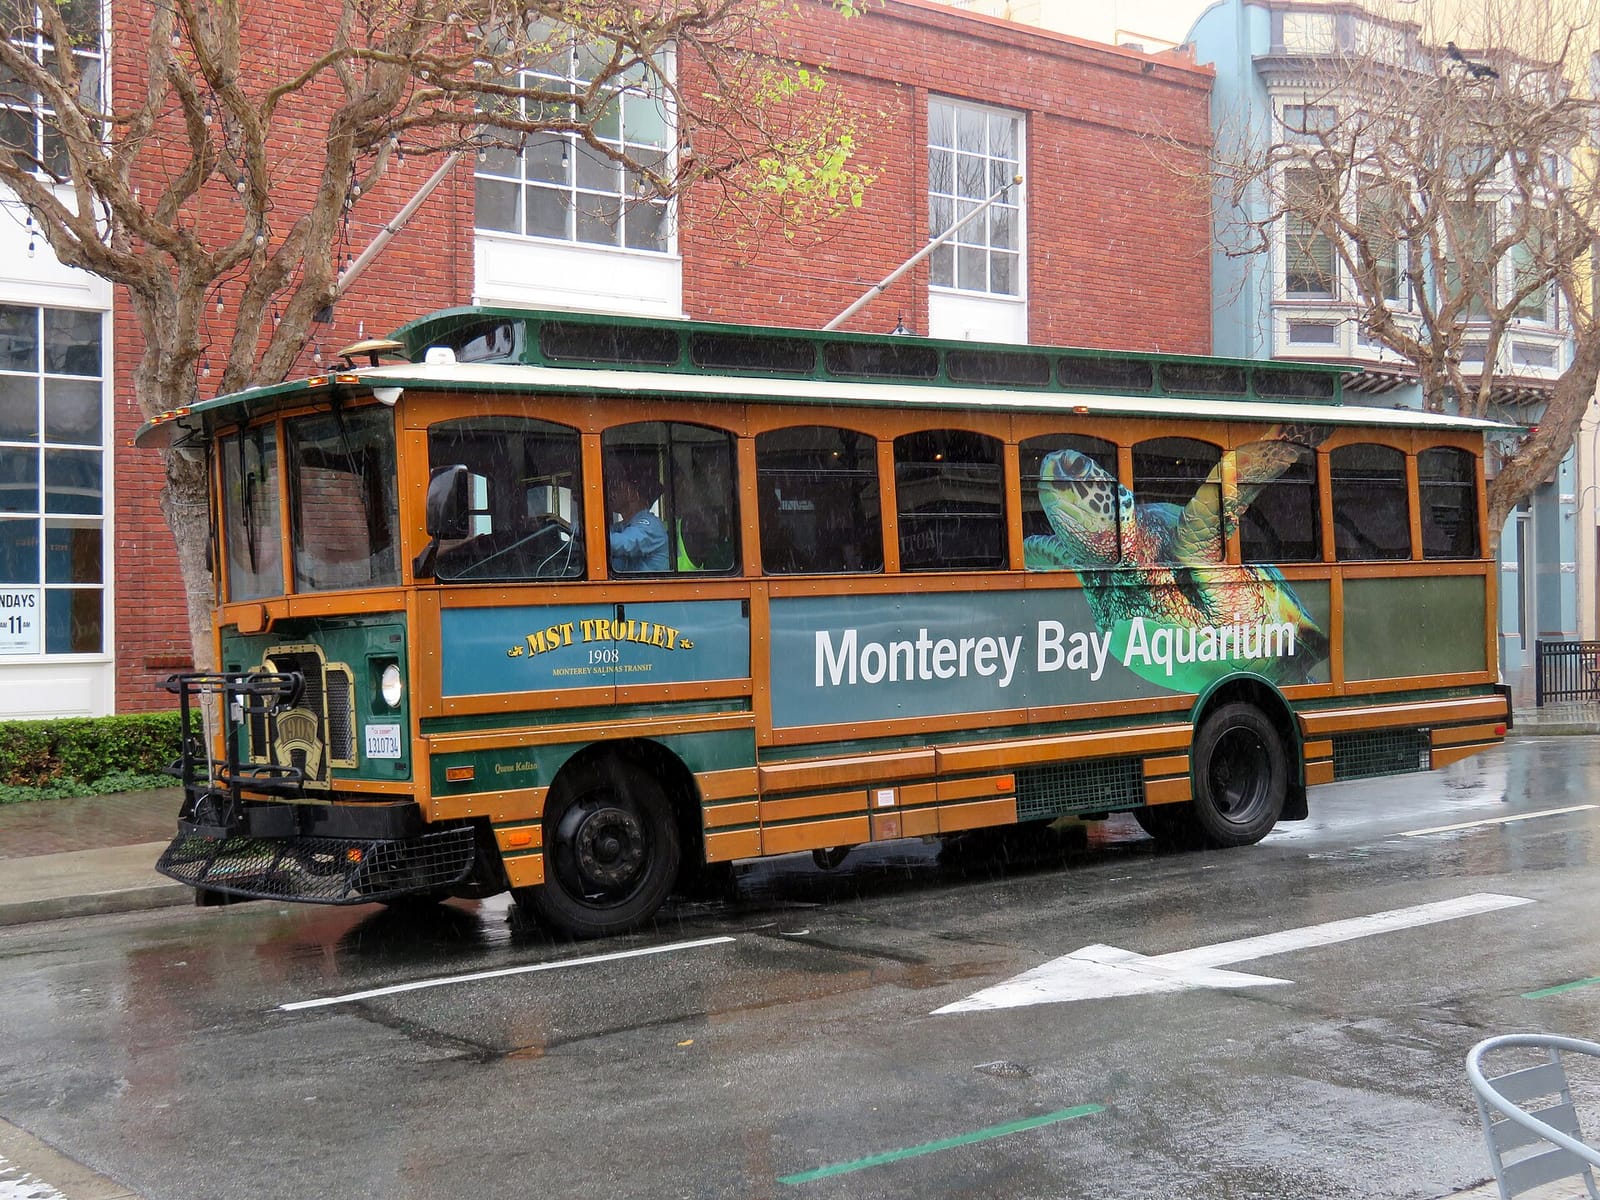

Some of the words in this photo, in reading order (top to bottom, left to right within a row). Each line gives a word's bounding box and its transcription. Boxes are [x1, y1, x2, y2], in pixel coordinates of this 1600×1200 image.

[525, 622, 574, 658] MST
[580, 618, 680, 650] TROLLEY
[588, 649, 619, 665] 1908
[815, 628, 1023, 687] Monterey
[1037, 620, 1113, 681] Bay
[1123, 616, 1296, 676] Aquarium
[552, 667, 592, 677] MONTEREY
[593, 665, 623, 675] SALINAS
[624, 664, 653, 673] TRANSIT
[368, 737, 398, 753] 1310734
